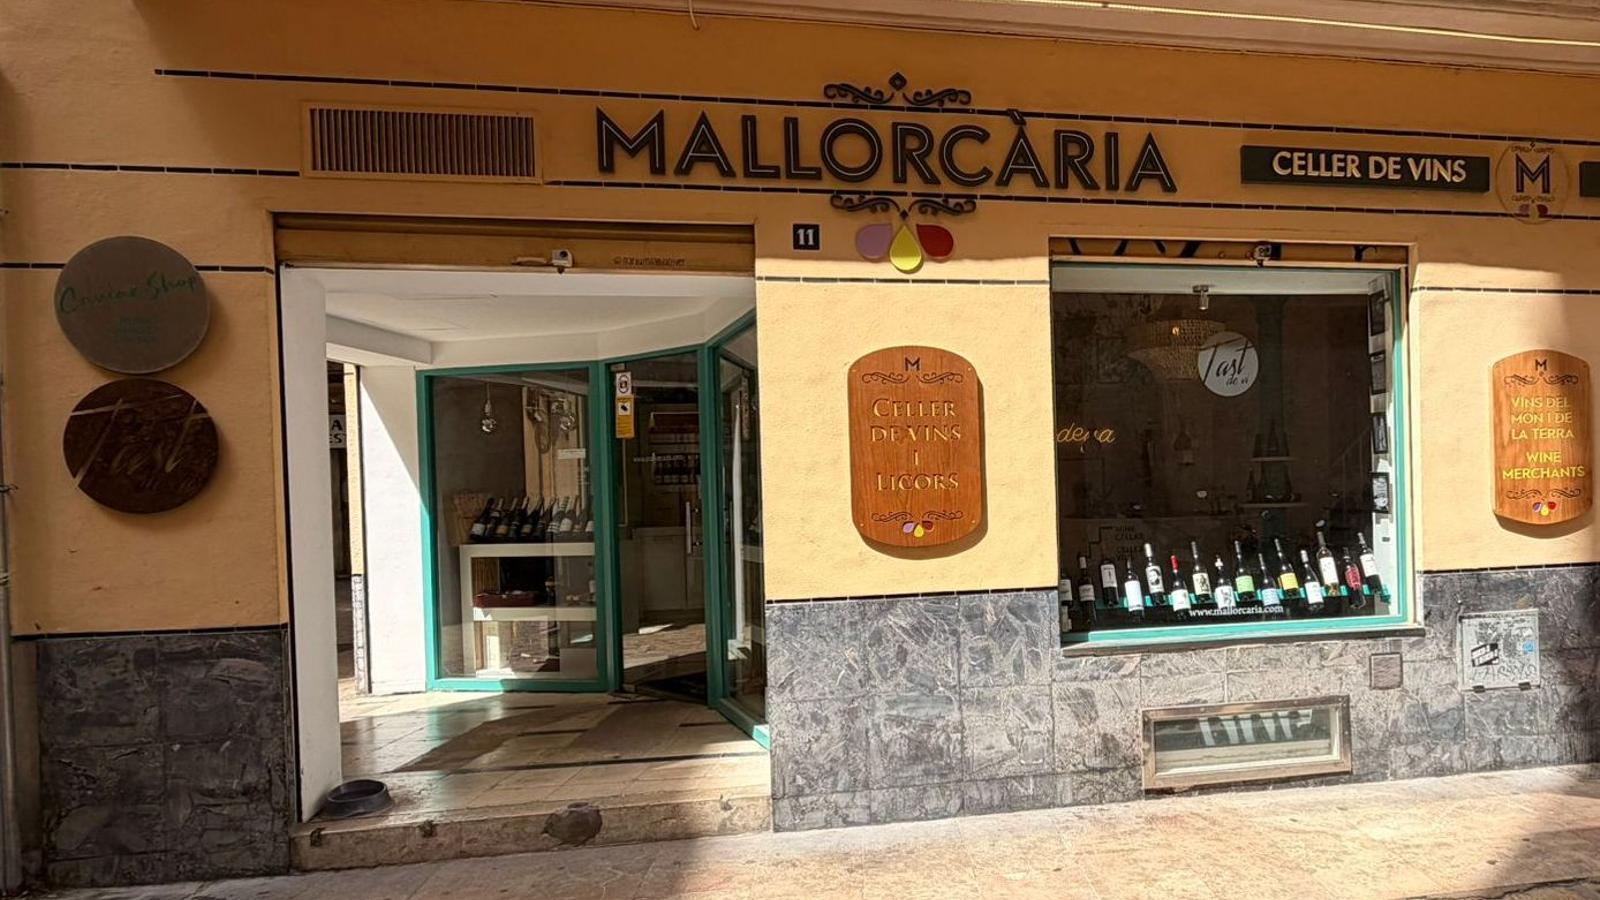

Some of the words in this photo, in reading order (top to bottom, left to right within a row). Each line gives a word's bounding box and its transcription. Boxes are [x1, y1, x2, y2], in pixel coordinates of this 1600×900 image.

[596, 106, 1178, 194] MALLORCÀRIA
[1272, 151, 1362, 178] CELLER
[1368, 156, 1402, 180] DE
[1406, 158, 1468, 184] VINS
[1515, 153, 1551, 194] M
[796, 228, 815, 245] 11
[904, 357, 921, 372] M
[1535, 359, 1548, 371] M
[1511, 397, 1544, 409] VINS
[1546, 396, 1571, 409] DEL
[1555, 412, 1573, 424] DE
[870, 425, 900, 442] DE
[906, 424, 962, 442] VINS
[1511, 428, 1528, 440] LA
[1532, 428, 1576, 440] TERRA
[1526, 451, 1562, 463] WINE
[1502, 466, 1586, 480] MERCHANTS
[876, 472, 959, 491] LICORS
[1189, 604, 1284, 617] www.mallorcaria.com
